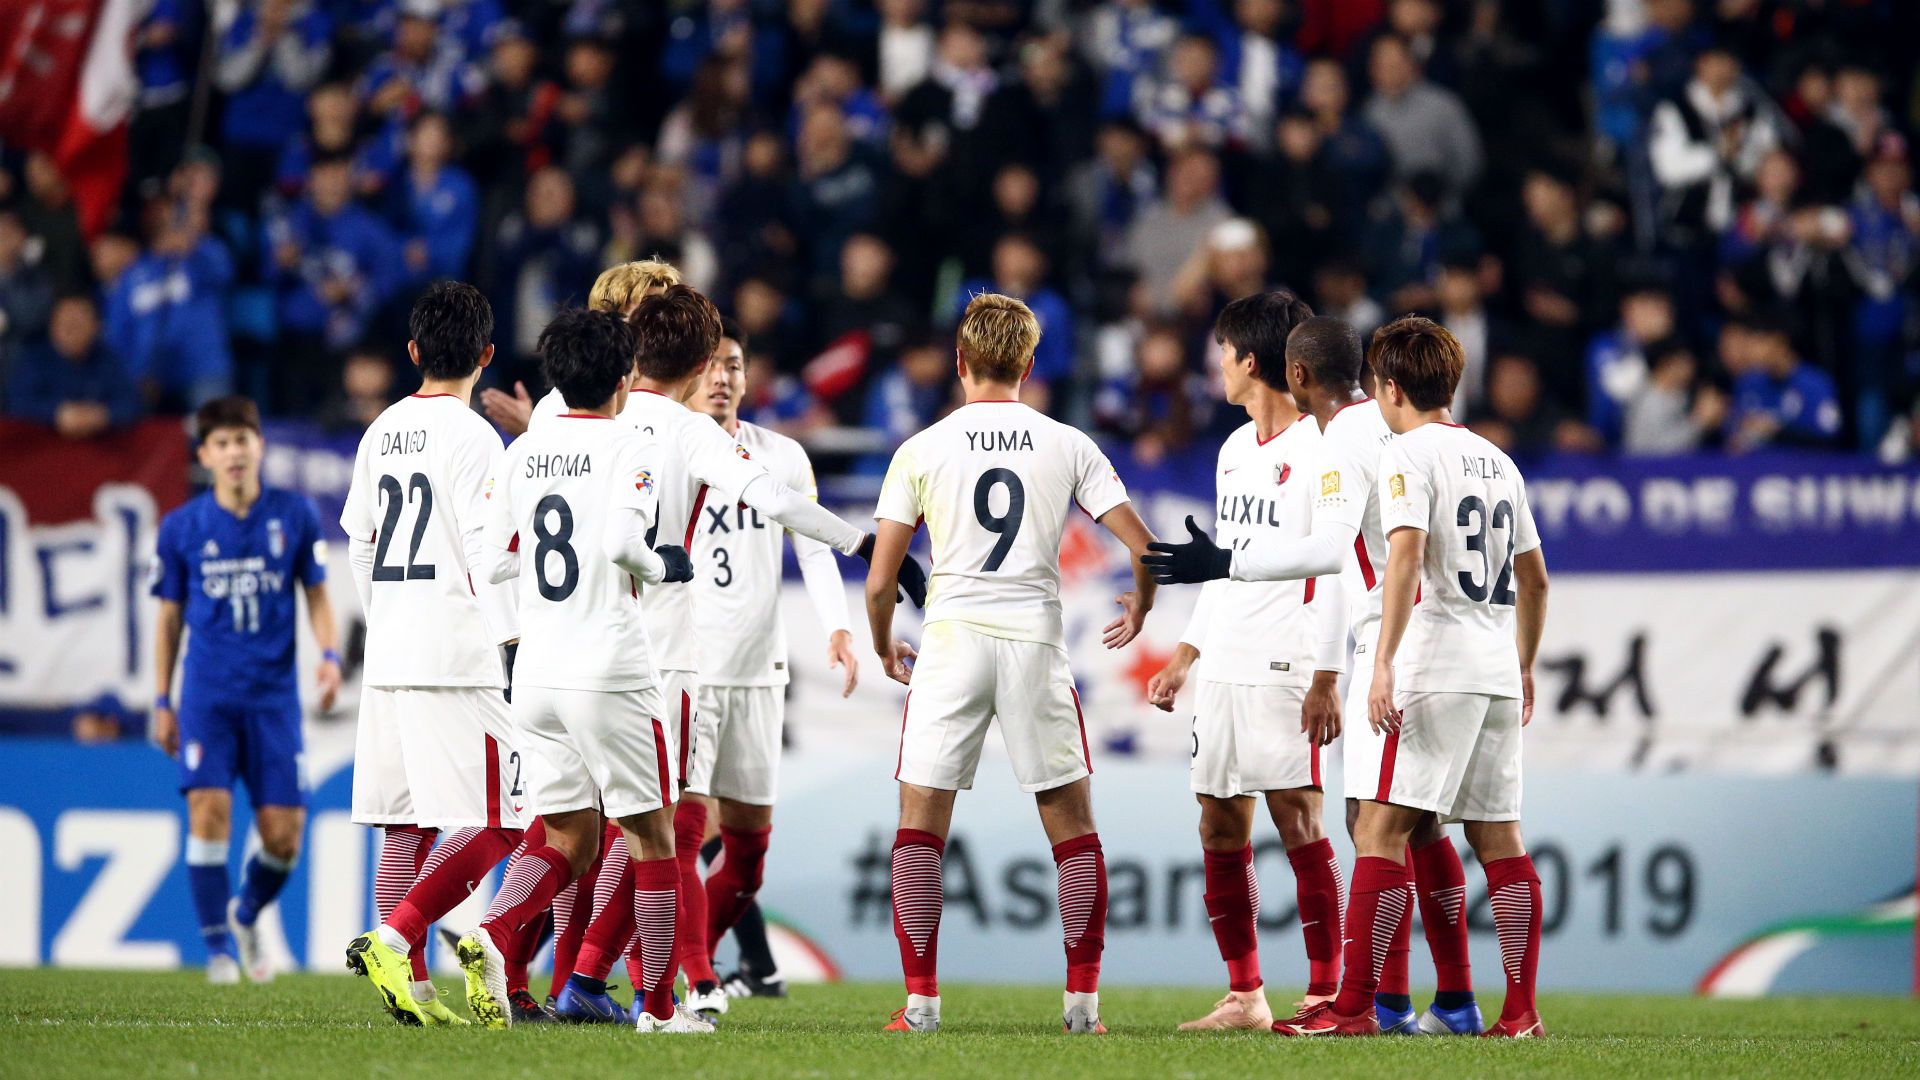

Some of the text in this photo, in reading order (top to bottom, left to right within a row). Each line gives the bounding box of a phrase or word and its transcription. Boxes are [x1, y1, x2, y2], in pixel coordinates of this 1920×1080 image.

[381, 429, 427, 456] DAIGO
[965, 430, 1034, 452] YUMA
[525, 454, 591, 479] SHOMA
[1461, 455, 1506, 480] ANZAI
[371, 472, 435, 582] 22
[973, 467, 1026, 572] 9
[1220, 494, 1280, 528] LIXIL
[533, 494, 580, 602] 8
[712, 547, 733, 588] 3
[1456, 495, 1517, 607] 32
[230, 594, 260, 633] 11
